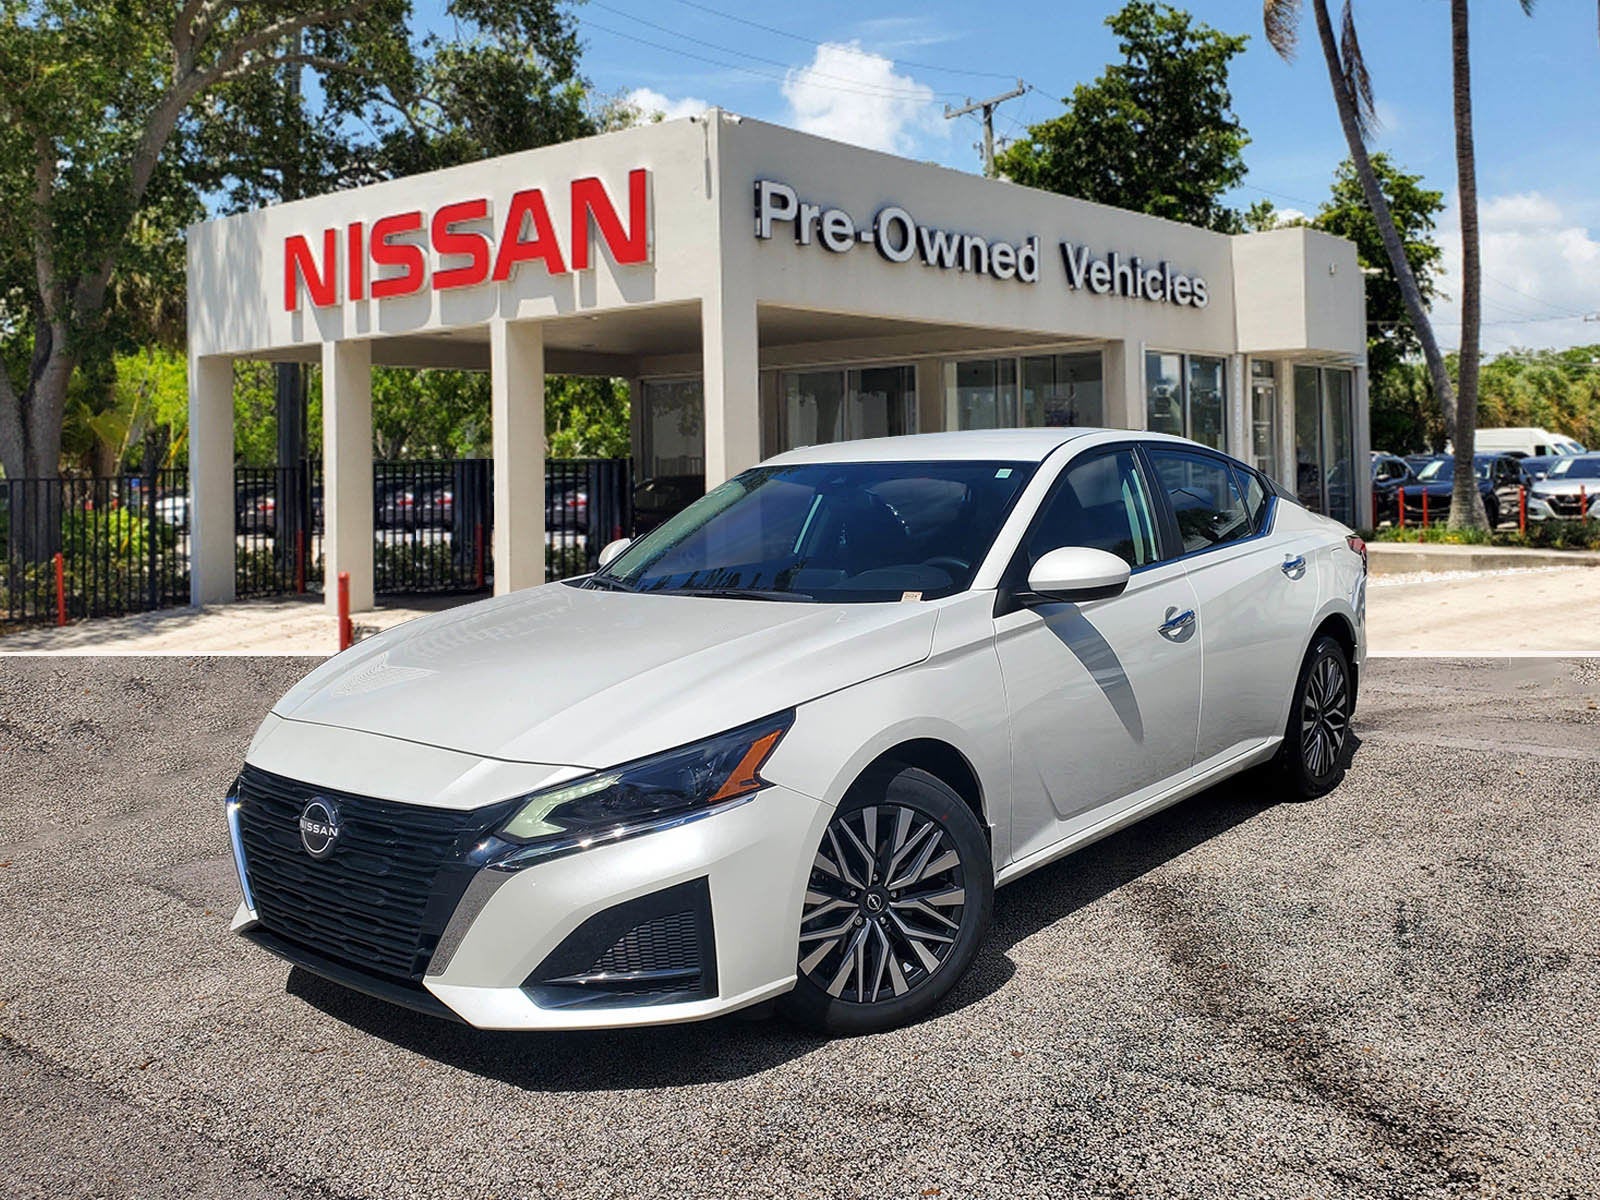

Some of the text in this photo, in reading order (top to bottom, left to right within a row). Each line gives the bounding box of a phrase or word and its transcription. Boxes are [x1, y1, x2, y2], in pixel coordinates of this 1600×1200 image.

[285, 168, 649, 312] NISSAN
[754, 179, 1209, 308] Pre-Owned Vehicles
[300, 819, 338, 837] NISSAN
